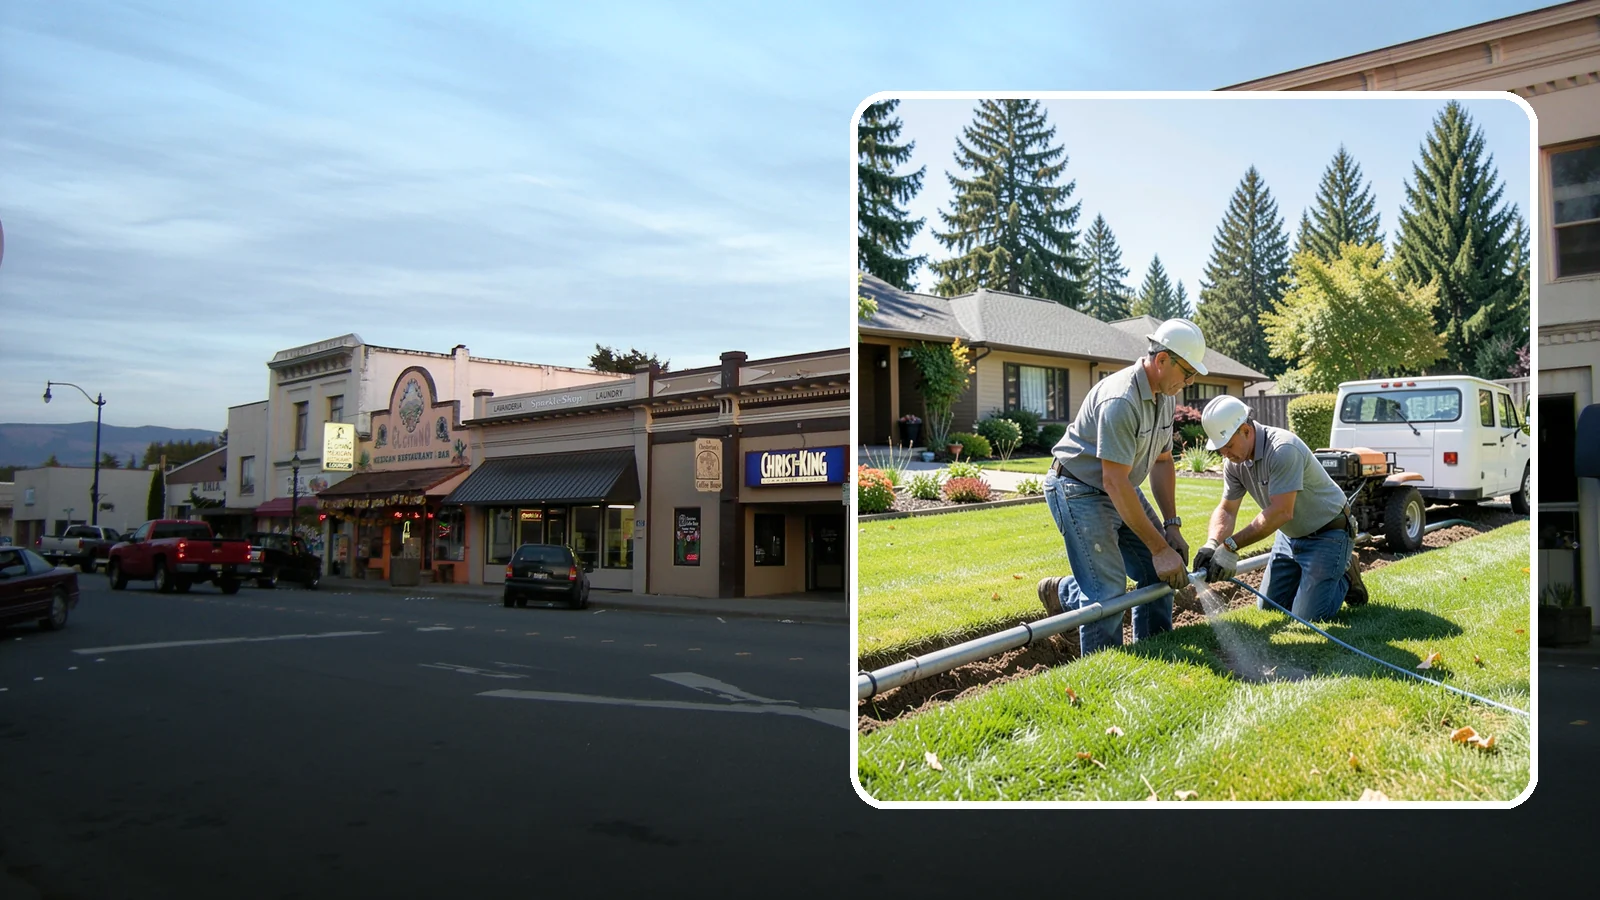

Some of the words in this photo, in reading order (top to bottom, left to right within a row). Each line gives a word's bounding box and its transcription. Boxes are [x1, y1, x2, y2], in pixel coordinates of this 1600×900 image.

[562, 394, 582, 404] Shop
[595, 389, 623, 400] LAUNDRY
[493, 402, 522, 412] LAVANDERIA
[374, 455, 396, 464] MEXICAN
[397, 452, 433, 462] RESTAURANT
[437, 450, 450, 459] BAR
